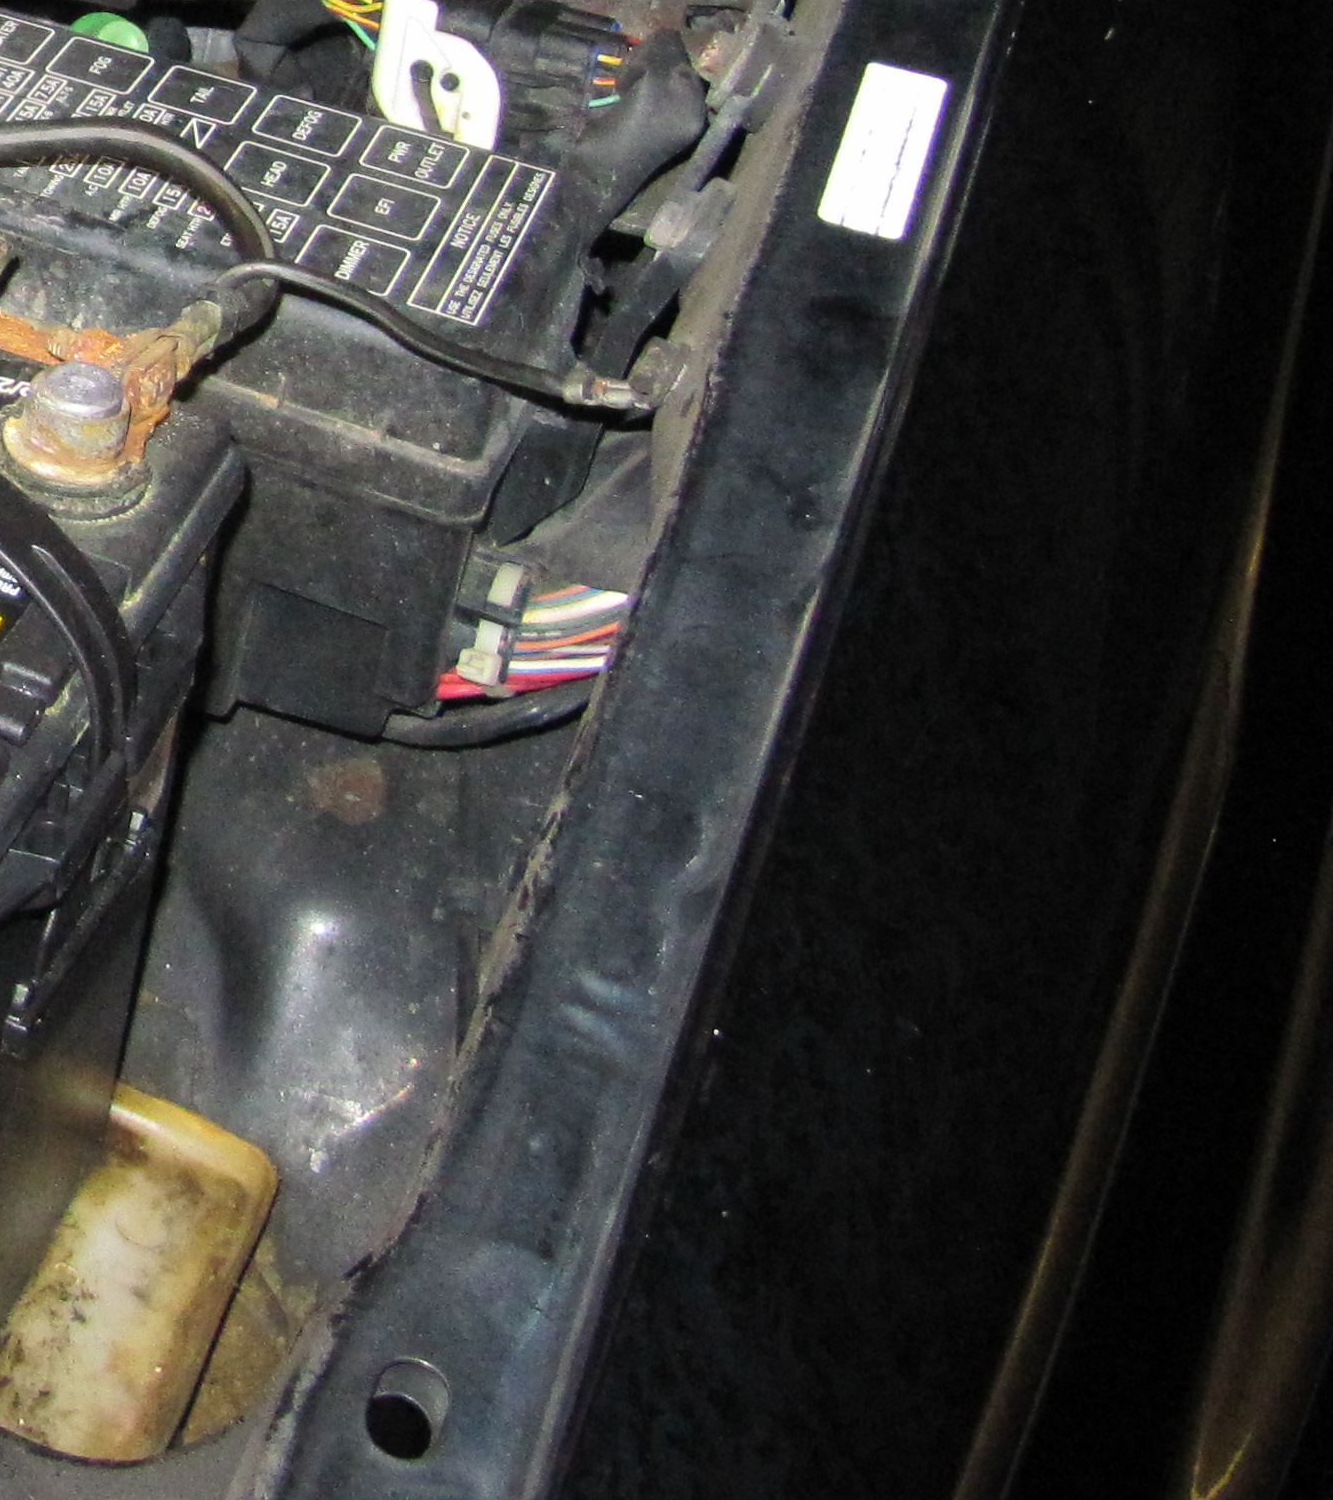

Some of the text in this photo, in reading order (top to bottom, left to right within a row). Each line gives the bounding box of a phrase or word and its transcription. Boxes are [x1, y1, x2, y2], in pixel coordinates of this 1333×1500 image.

[87, 55, 112, 74] FOG
[0, 69, 24, 89] 40A
[33, 78, 60, 99] 7.5A
[84, 93, 108, 112] 15A
[188, 83, 214, 104] TAIL
[291, 109, 323, 140] DEFOG
[387, 140, 412, 162] PWR
[413, 142, 447, 179] OUTLET
[126, 171, 151, 192] 10A
[260, 160, 288, 187] HEAD
[373, 197, 395, 215] EFI
[267, 214, 292, 236] 15A
[449, 212, 481, 248] NOTICE
[334, 239, 370, 280] DIMMER
[444, 299, 461, 314] USE
[454, 283, 470, 297] THE
[462, 243, 492, 282] DESIGNATED
